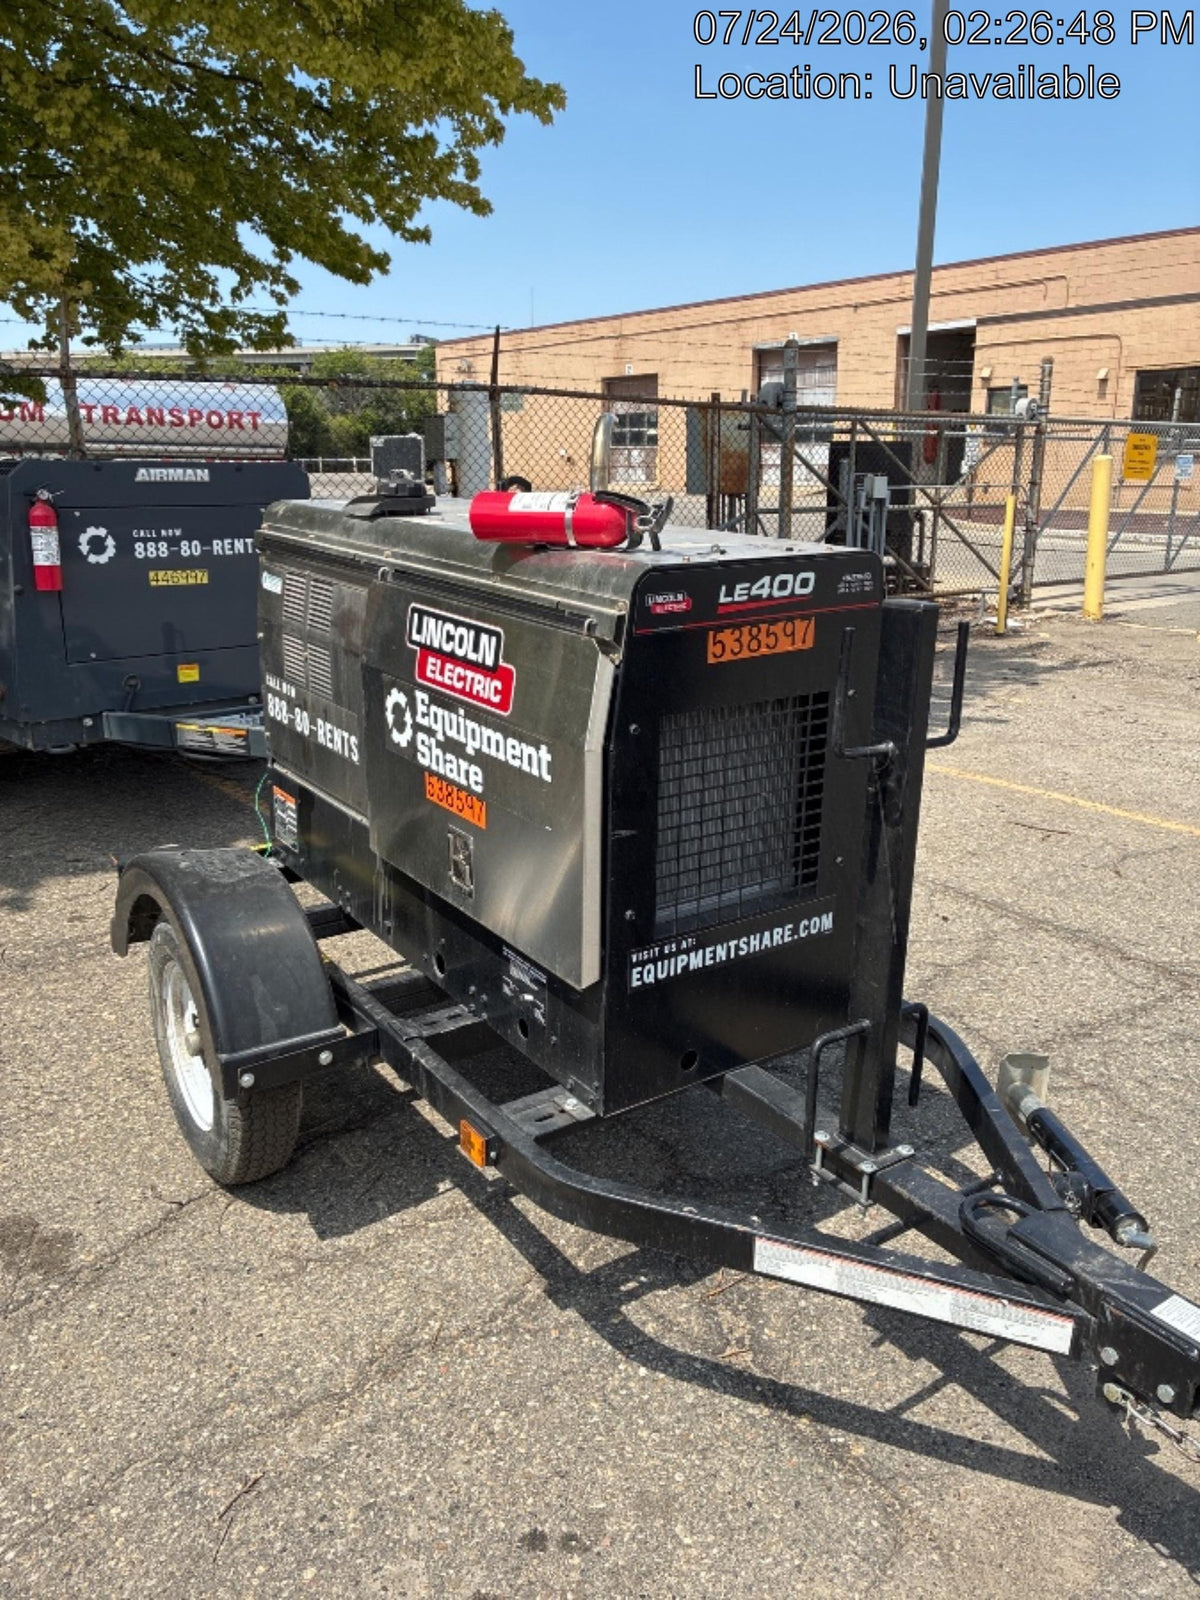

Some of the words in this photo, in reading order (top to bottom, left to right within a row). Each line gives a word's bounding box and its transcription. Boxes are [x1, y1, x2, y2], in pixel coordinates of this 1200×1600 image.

[80, 404, 261, 430] TRANSPORT
[135, 467, 210, 483] AIRMAN
[132, 529, 157, 538] CALL
[161, 528, 182, 537] NOW
[719, 571, 816, 603] LE400
[411, 612, 497, 668] LINCOLN
[711, 618, 813, 660] 538597
[426, 656, 503, 704] ELECTRIC
[268, 693, 359, 763] 888-80-RENTS
[415, 689, 552, 783] Equipment
[416, 732, 484, 794] Share
[427, 776, 486, 824] 538597
[631, 911, 834, 988] EQUIPMENTSHARE.COM
[631, 947, 660, 963] VISIT
[664, 942, 677, 954] US
[681, 938, 697, 951] AT:
